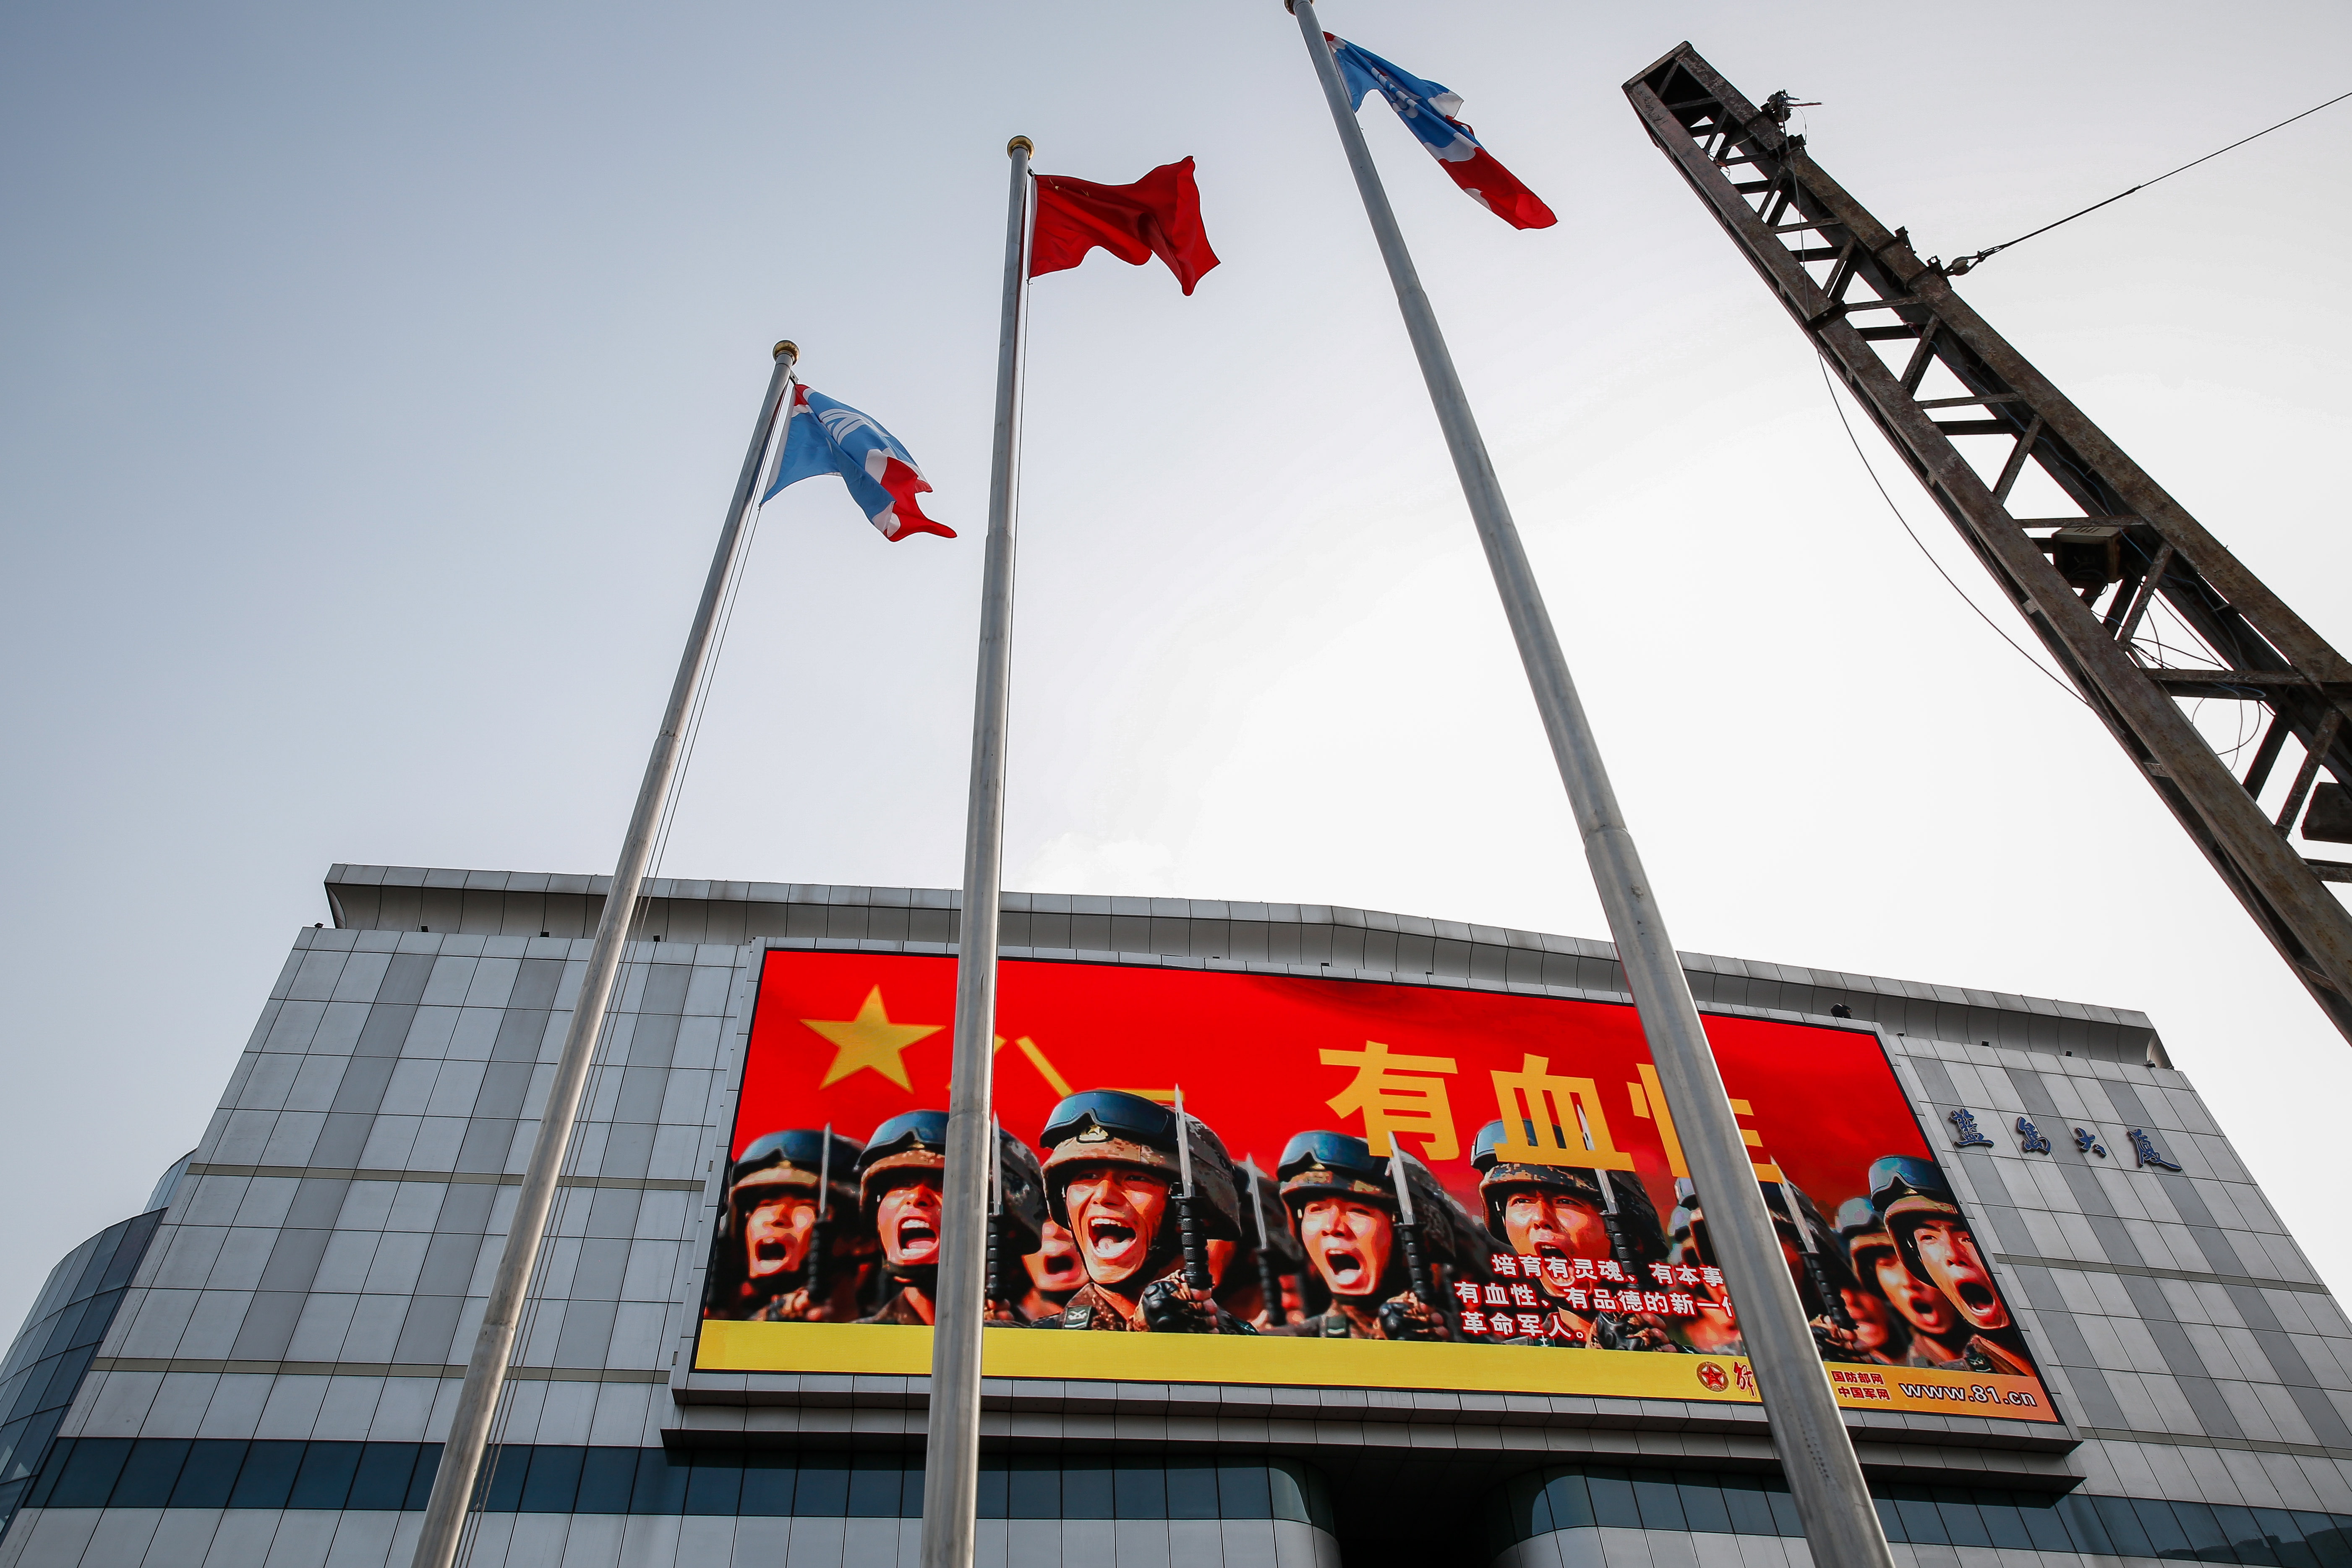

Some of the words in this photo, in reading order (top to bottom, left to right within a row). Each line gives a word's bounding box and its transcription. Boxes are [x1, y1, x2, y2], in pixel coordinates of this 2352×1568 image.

[1462, 1311, 1585, 1339] 革命军人。
[1831, 1370, 1884, 1385] 国防部网
[1837, 1386, 1890, 1400] 中国军网
[1898, 1382, 2038, 1407] www.81.cn
